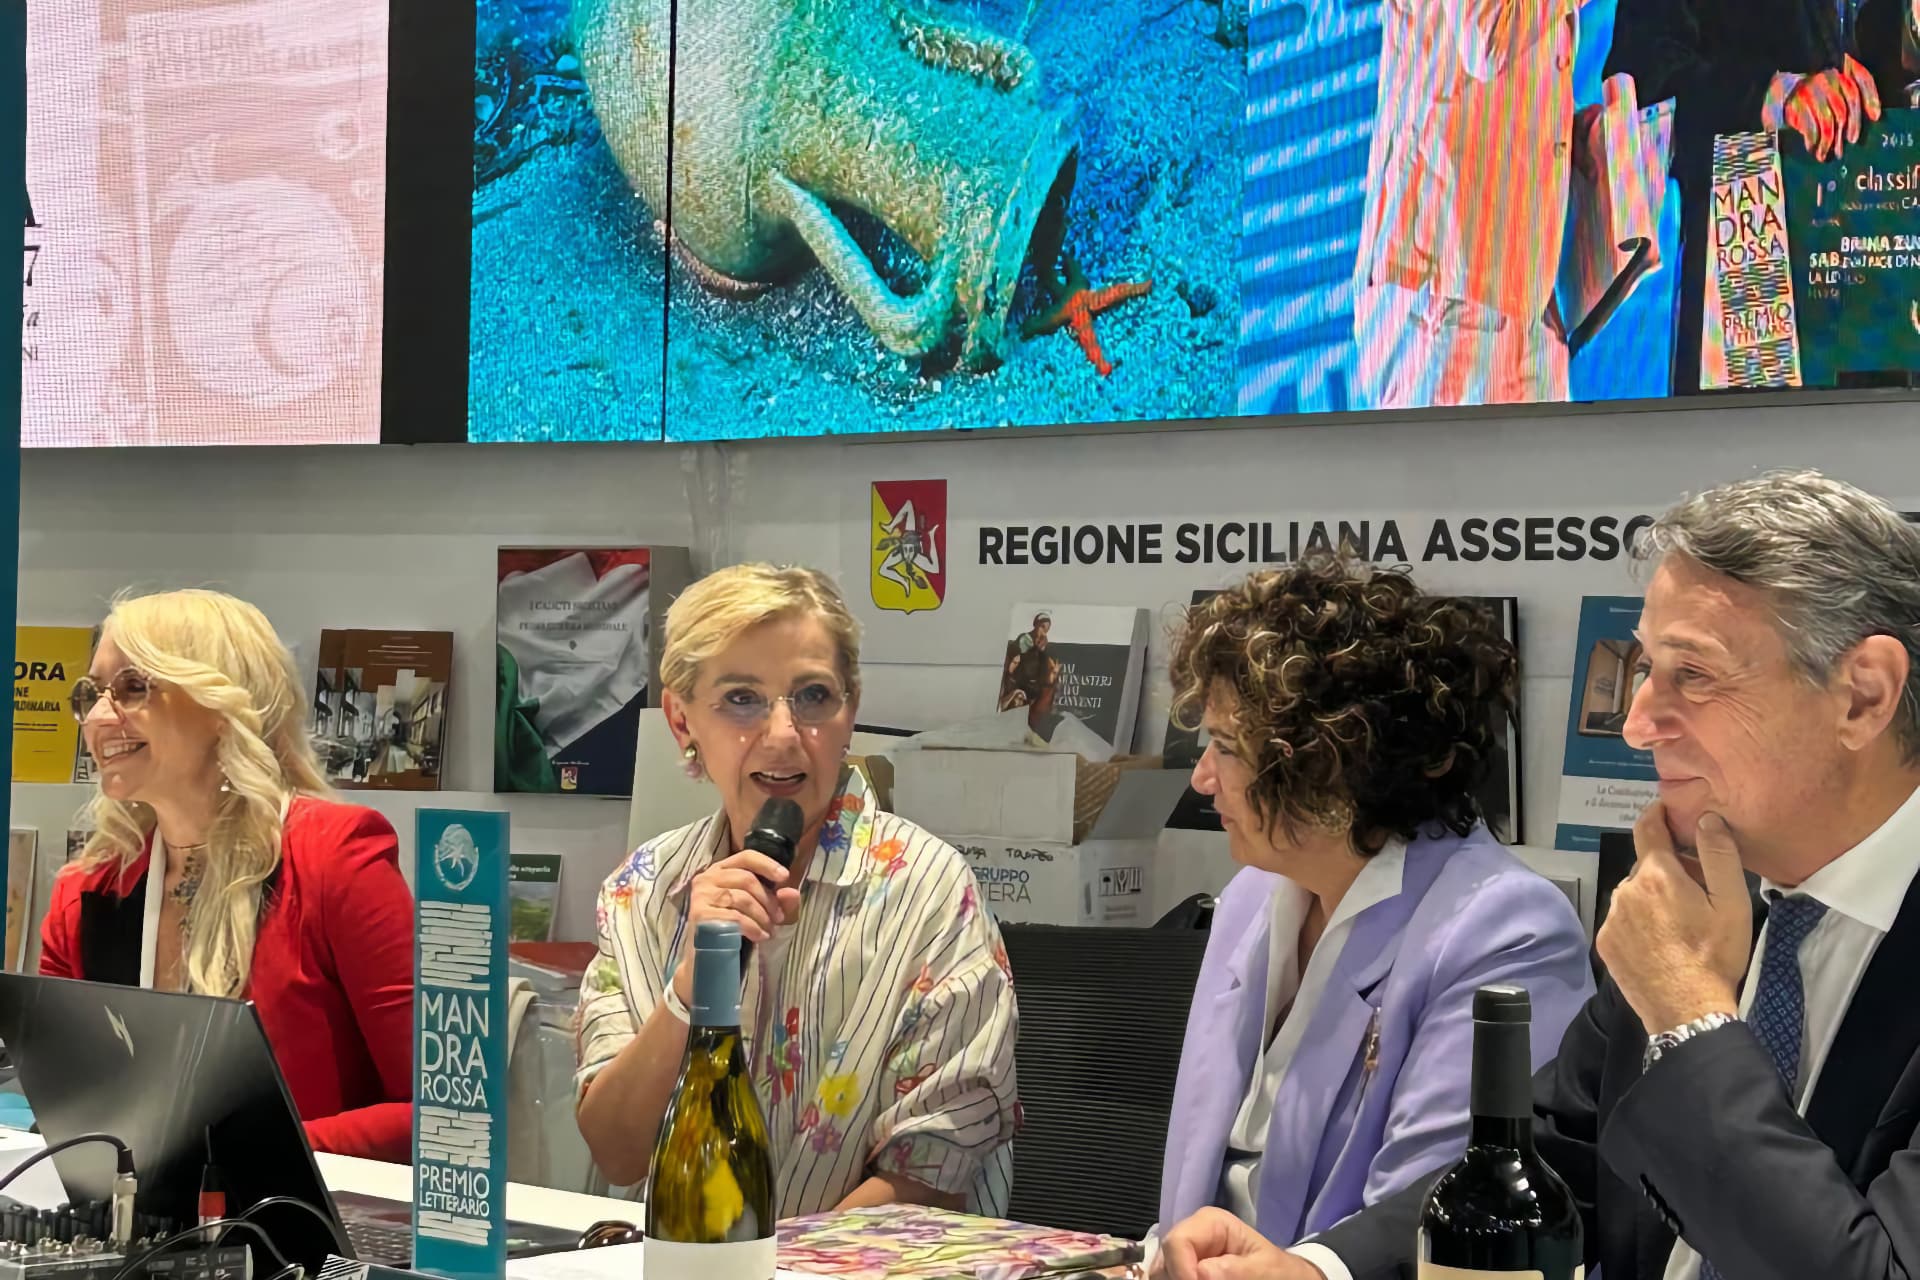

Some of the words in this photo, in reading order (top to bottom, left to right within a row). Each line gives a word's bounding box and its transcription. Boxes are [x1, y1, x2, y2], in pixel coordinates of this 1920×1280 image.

[1715, 171, 1780, 214] MAN
[1716, 204, 1783, 248] DRA
[1717, 234, 1785, 271] ROSSA
[978, 523, 1163, 565] REGIONE
[1174, 519, 1408, 564] SICILIANA
[421, 991, 489, 1037] MAN
[421, 1030, 488, 1079] DRA
[421, 1071, 488, 1109] ROSSA
[420, 1163, 490, 1199] PREMIO
[420, 1190, 490, 1217] LETTERARIO
